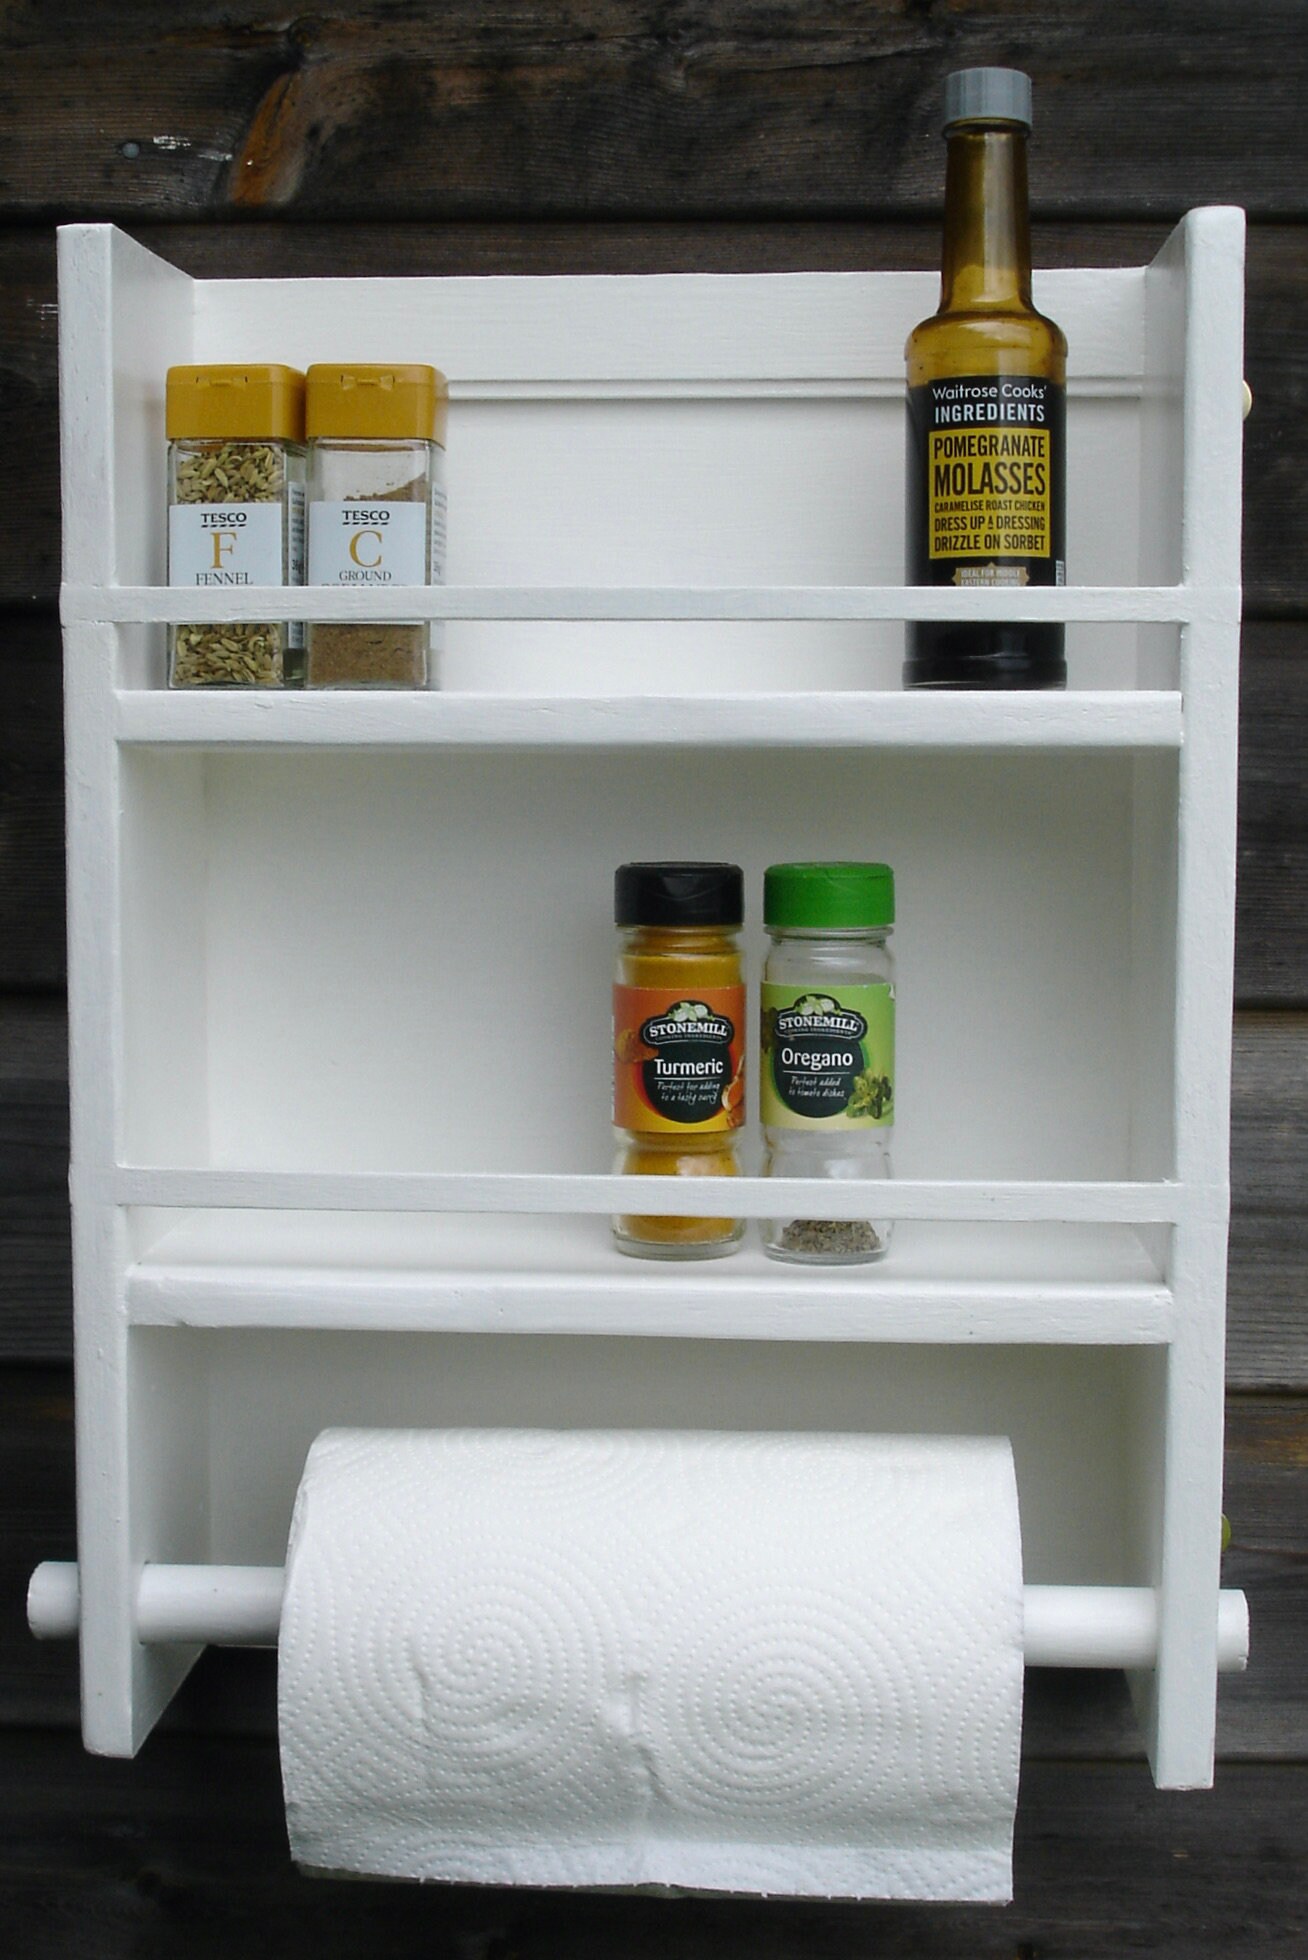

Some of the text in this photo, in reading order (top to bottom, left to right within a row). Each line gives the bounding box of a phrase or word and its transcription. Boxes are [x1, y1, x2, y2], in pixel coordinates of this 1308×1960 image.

[933, 385, 998, 400] Waitrose
[935, 403, 1045, 423] INGREDIENTS
[934, 434, 1045, 459] POMEGRANATE
[934, 462, 1045, 497] MOLASSES
[935, 500, 1045, 513] CARAMELISE ROAST CHICKEN
[201, 512, 247, 523] TESCO
[342, 510, 390, 521] TESCO
[935, 516, 967, 532] DRESS
[970, 516, 985, 530] UP
[997, 516, 1045, 531] DRESSING
[210, 531, 238, 569] F
[349, 530, 382, 568] C
[935, 534, 1045, 552] DRIZZLE ON SORBET
[196, 572, 253, 586] FENNEL
[339, 571, 392, 581] GROUND
[649, 1022, 728, 1037] STONEMILL
[779, 1016, 857, 1031] STONEMILL
[654, 1058, 723, 1075] Turmeric
[782, 1048, 853, 1071] Oregano
